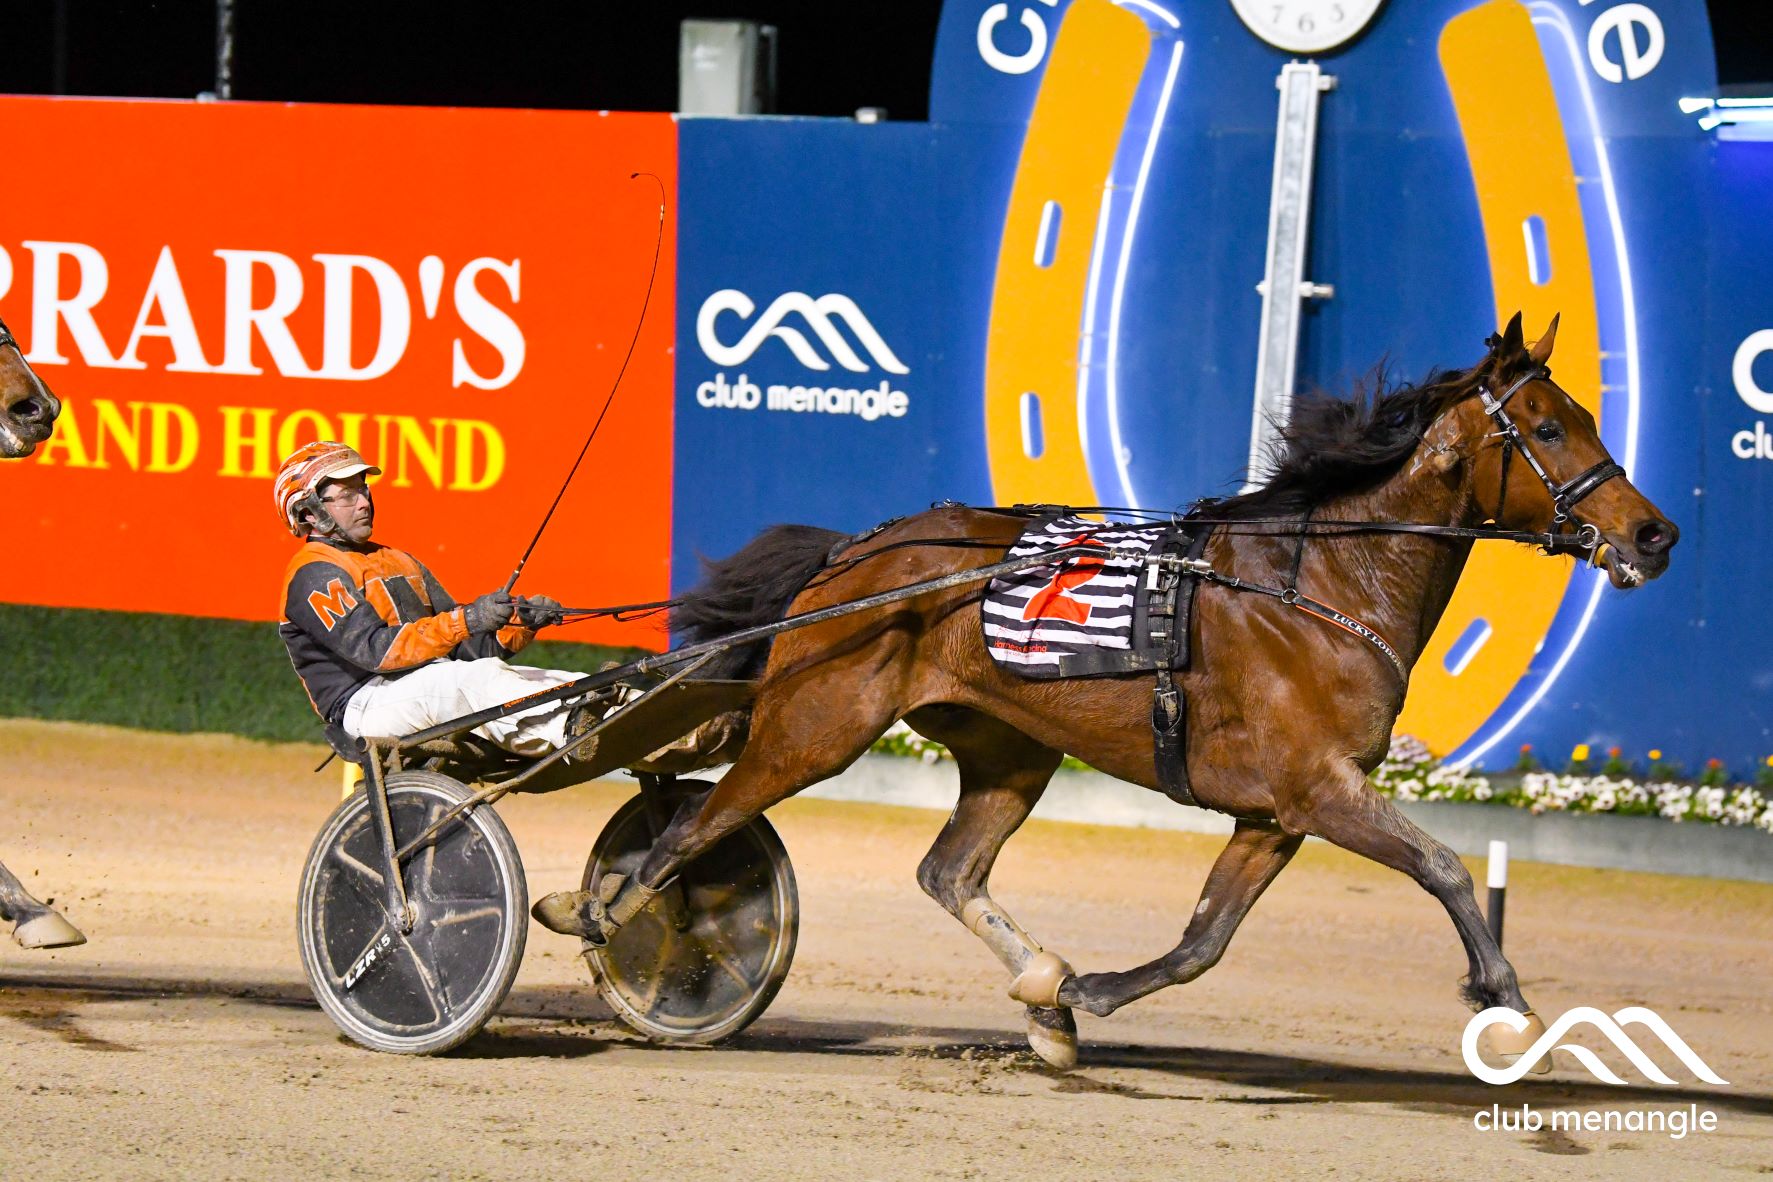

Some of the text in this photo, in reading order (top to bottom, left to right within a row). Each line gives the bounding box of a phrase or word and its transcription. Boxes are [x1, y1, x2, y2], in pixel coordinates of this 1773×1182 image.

[1298, 12, 1315, 33] 6
[1331, 3, 1344, 23] 5
[0, 240, 526, 391] RARD'S
[696, 372, 909, 421] club menangle
[36, 395, 200, 473] AND
[307, 578, 358, 632] M
[1333, 613, 1372, 638] LUCKY
[345, 948, 377, 989] LZR
